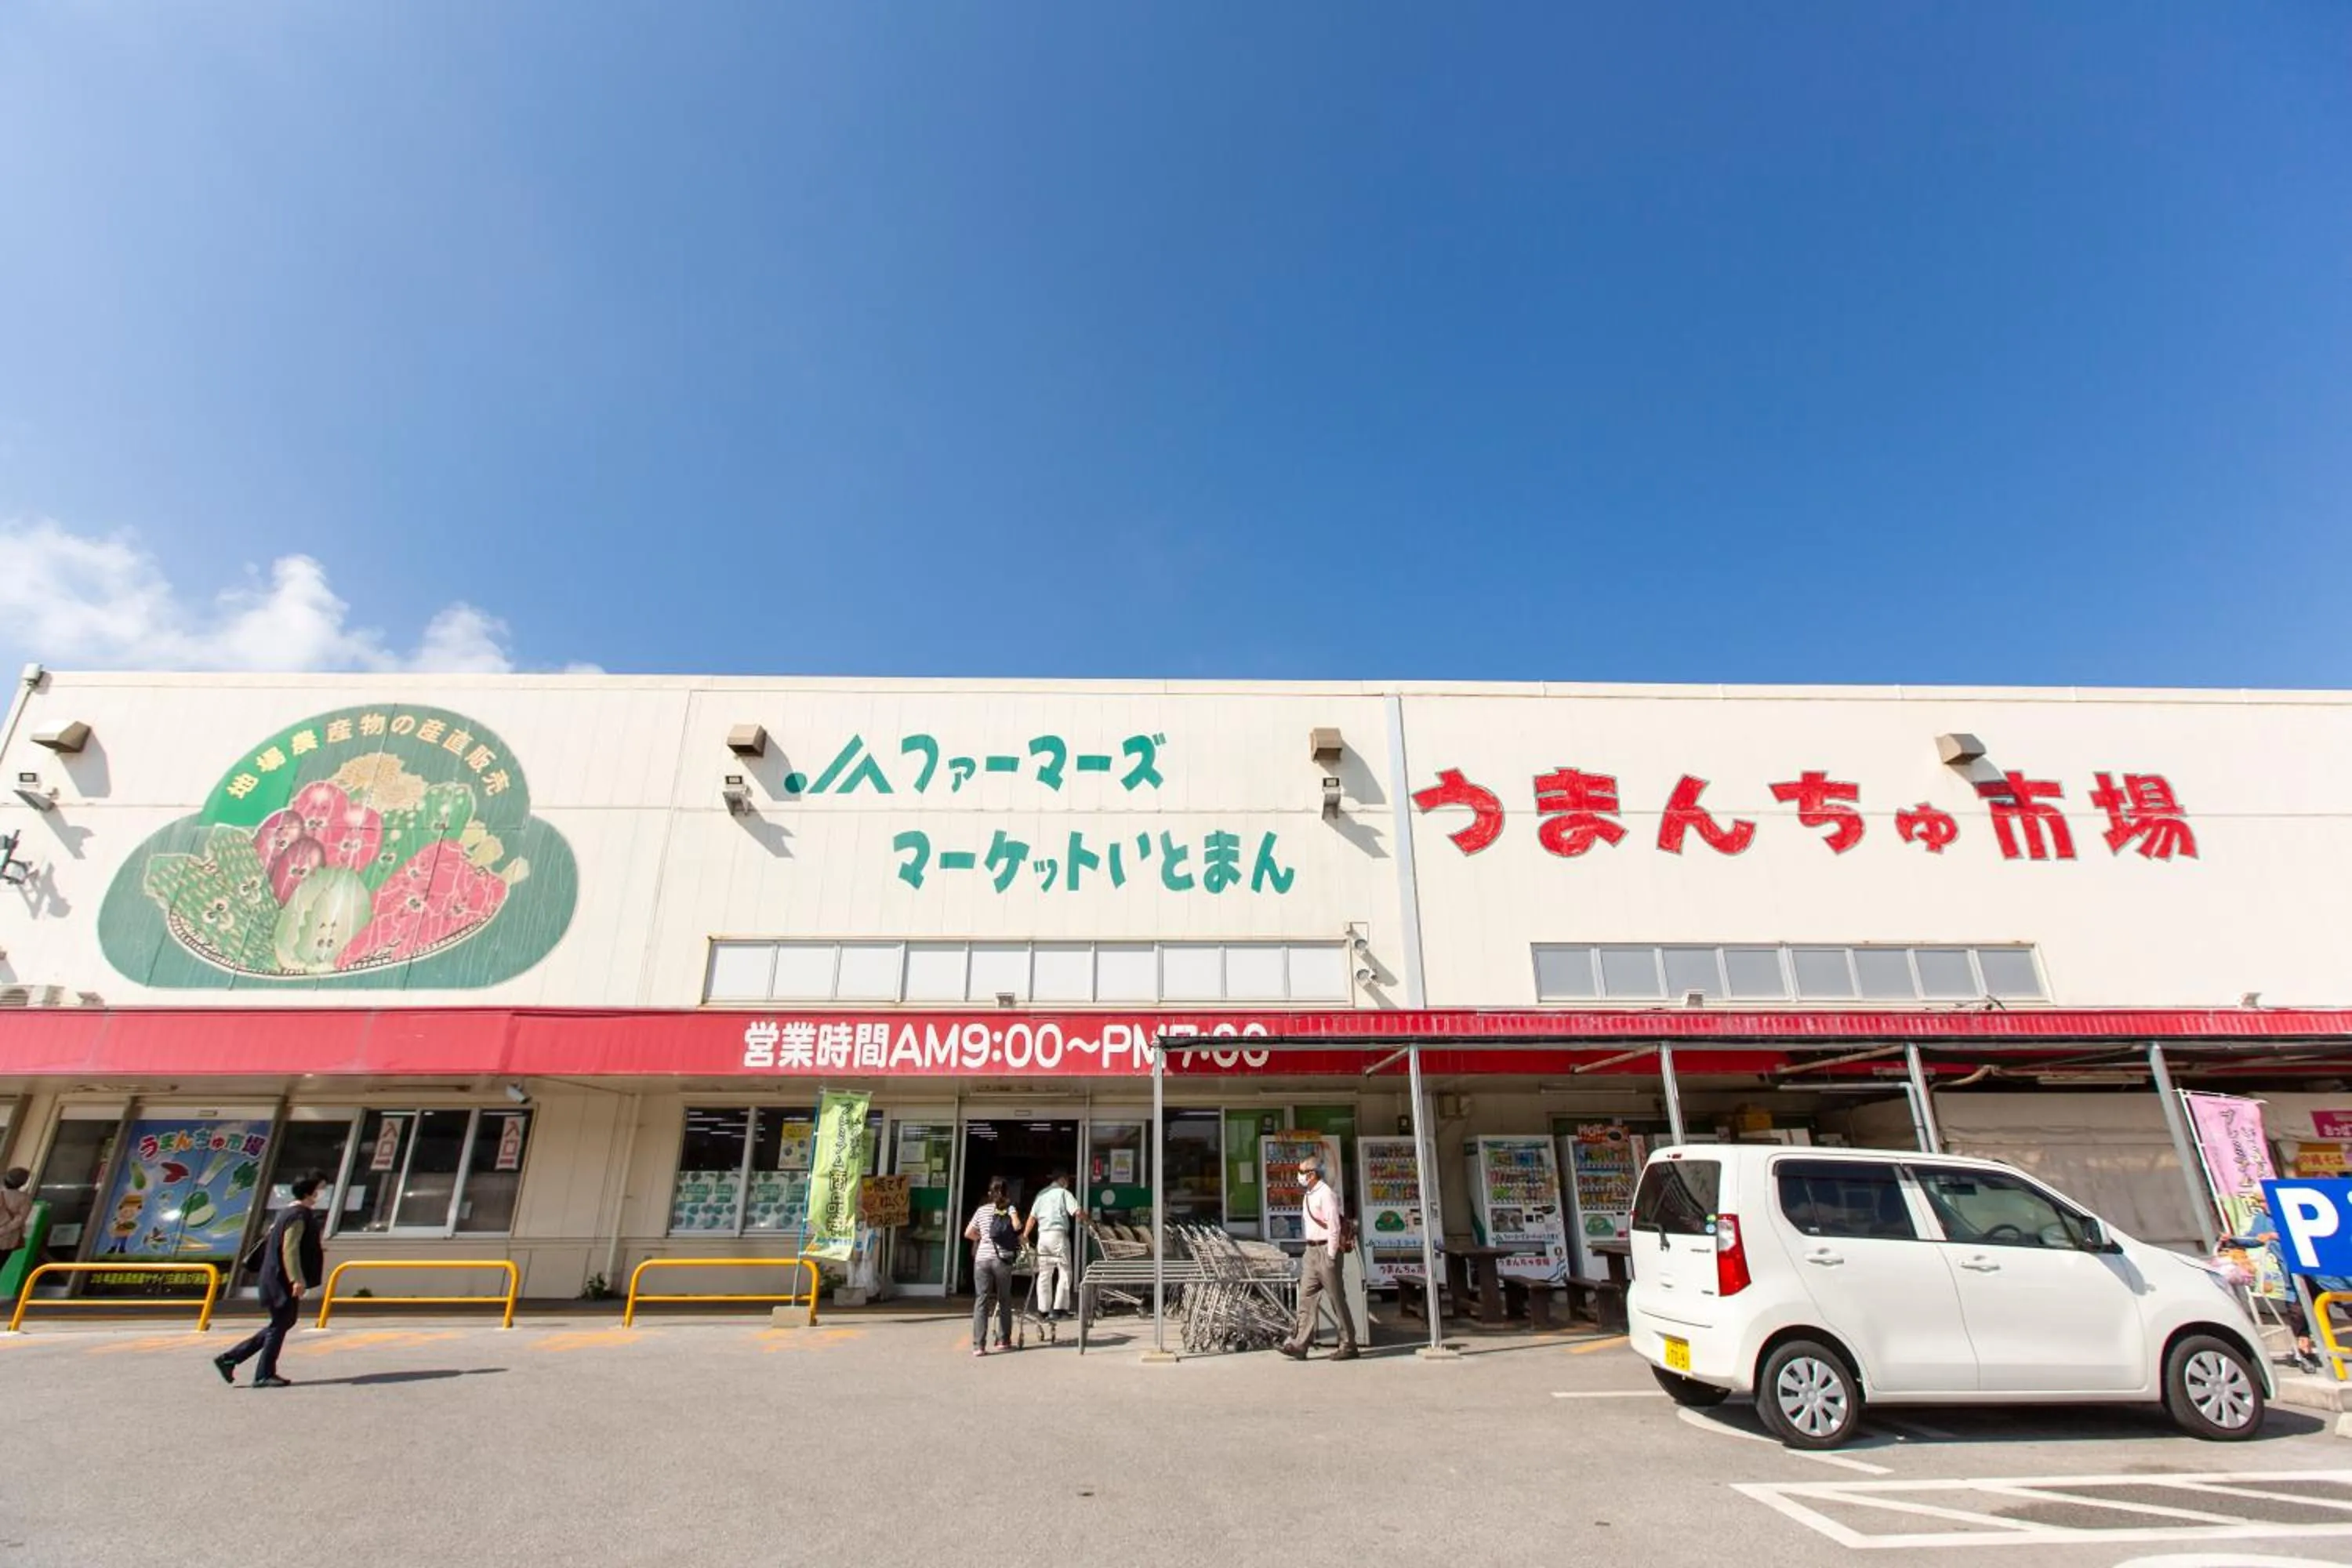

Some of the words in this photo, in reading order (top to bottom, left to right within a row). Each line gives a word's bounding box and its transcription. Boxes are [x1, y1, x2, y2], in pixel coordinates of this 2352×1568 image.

[1412, 766, 2198, 860] うまんちゅ市場
[893, 829, 1295, 895] マーケットいとまん
[2275, 1187, 2339, 1268] P
